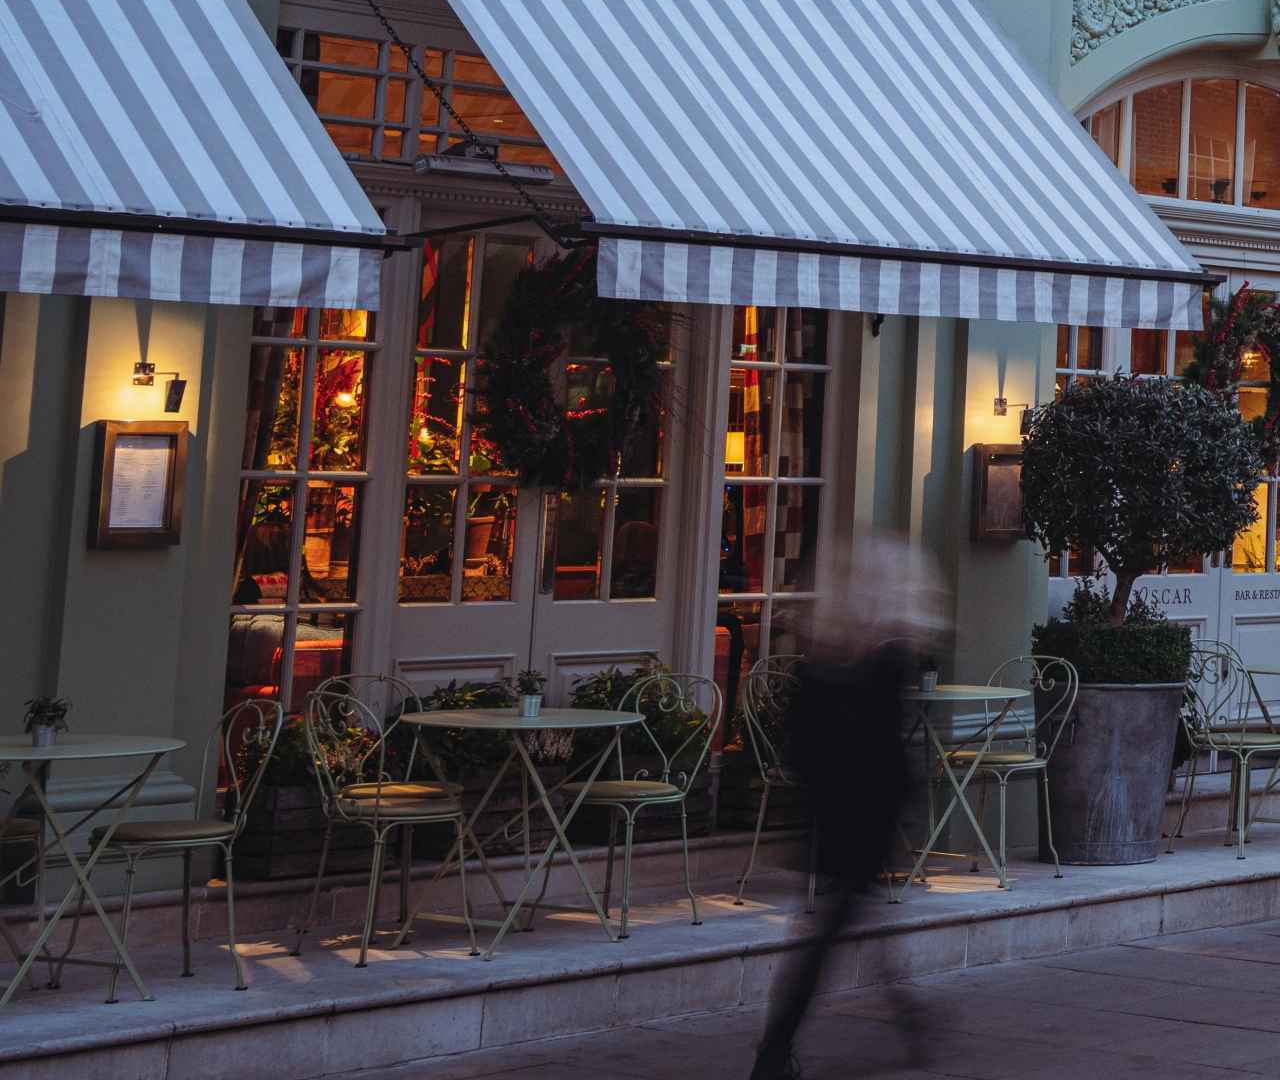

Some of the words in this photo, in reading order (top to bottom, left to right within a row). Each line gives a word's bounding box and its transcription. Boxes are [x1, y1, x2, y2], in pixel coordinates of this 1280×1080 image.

[1139, 586, 1193, 605] OSCAR
[1235, 589, 1251, 601] BAR
[1251, 592, 1259, 600] &
